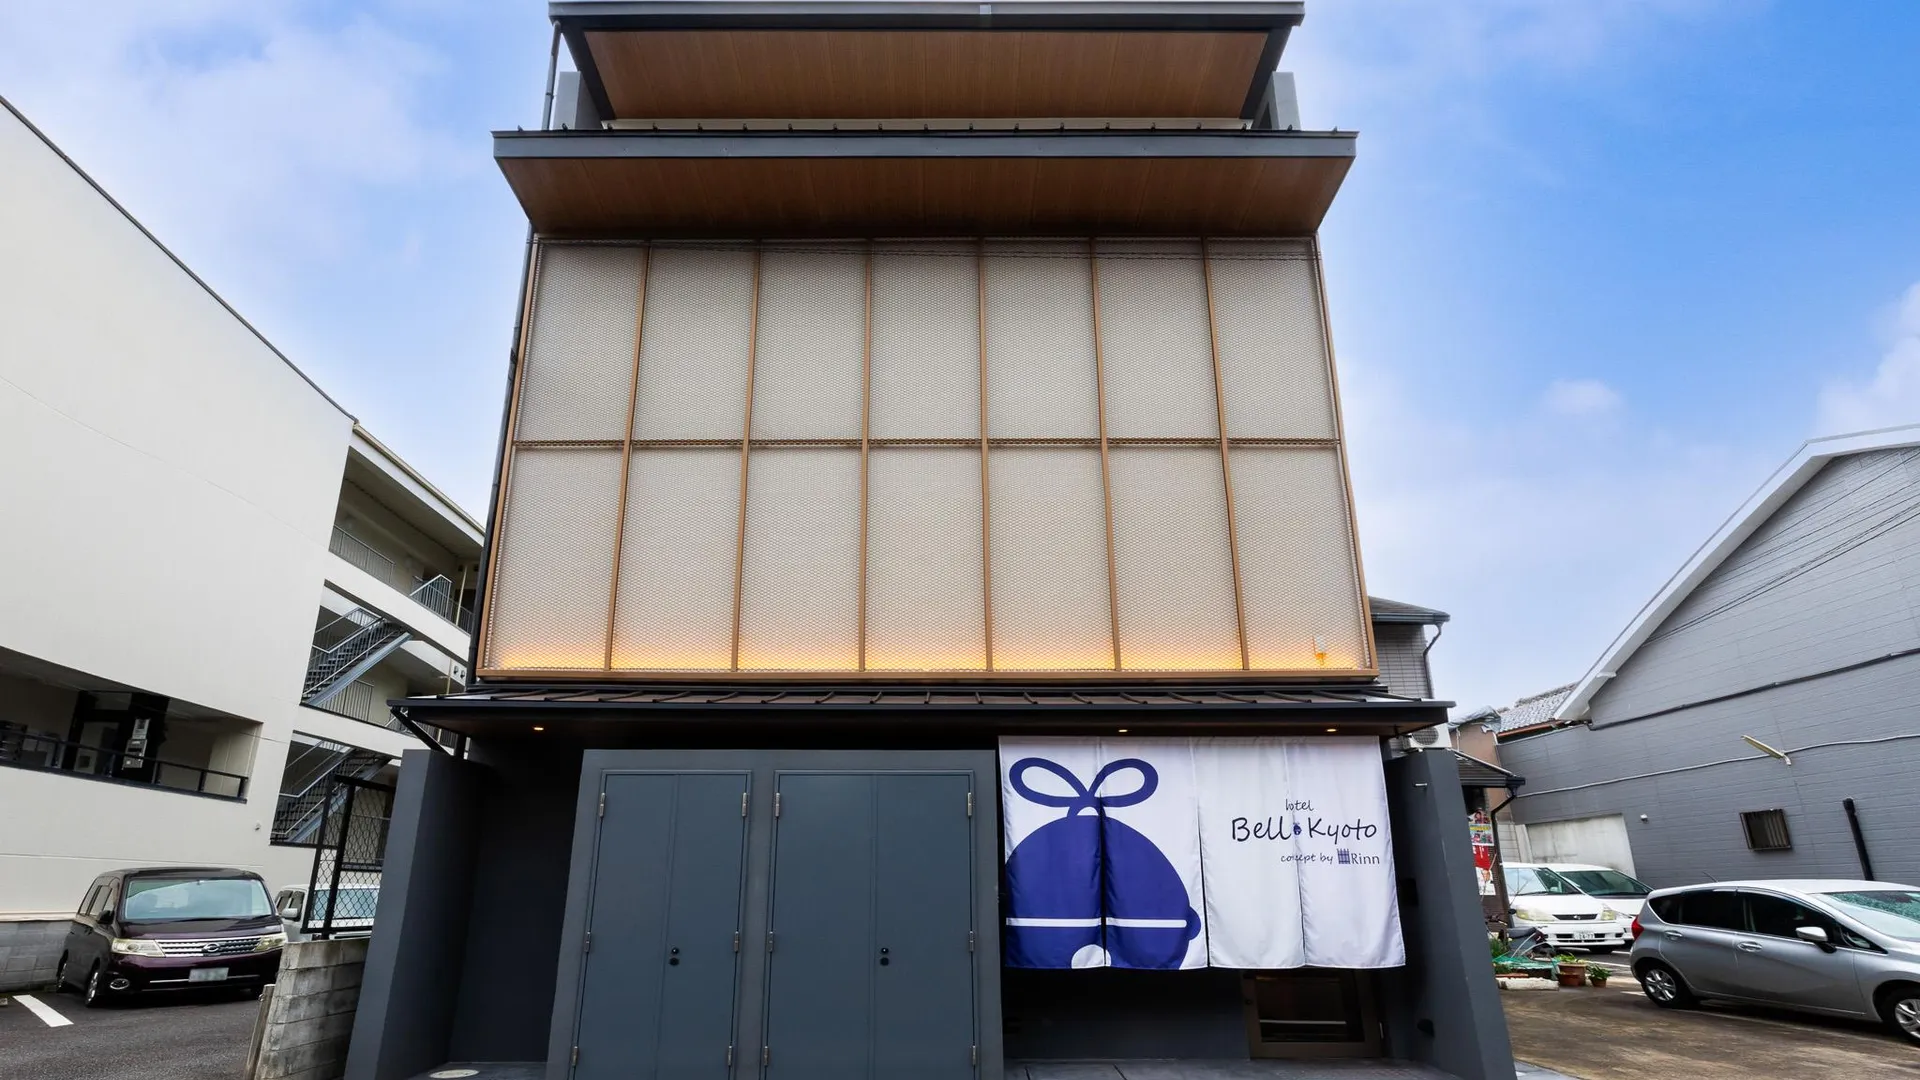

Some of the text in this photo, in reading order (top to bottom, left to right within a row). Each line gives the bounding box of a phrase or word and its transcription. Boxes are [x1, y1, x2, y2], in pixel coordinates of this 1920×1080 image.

[1231, 815, 1377, 845] Bell Kyoto
[1319, 852, 1334, 865] by
[1351, 853, 1380, 865] Rinn
